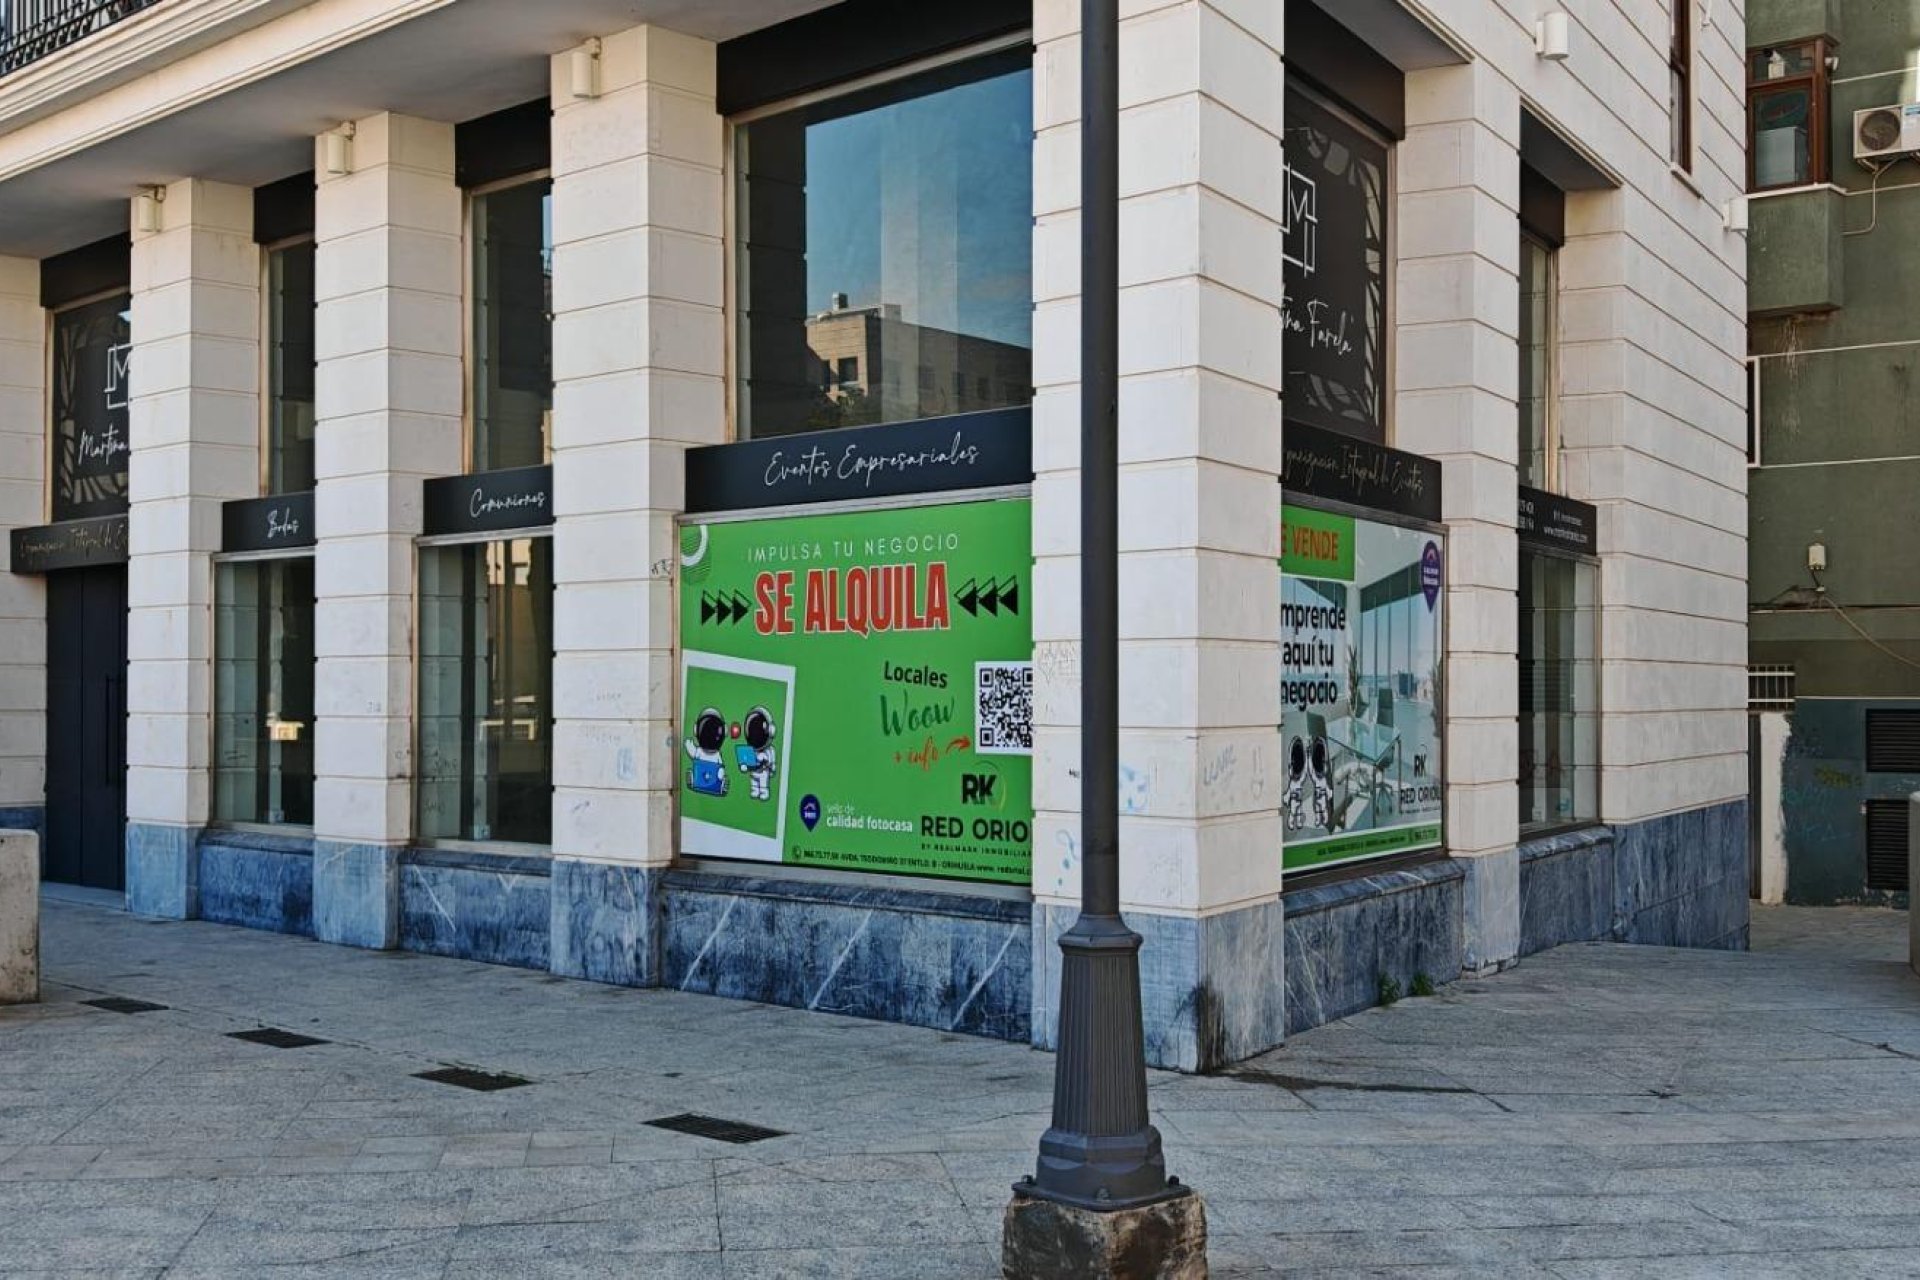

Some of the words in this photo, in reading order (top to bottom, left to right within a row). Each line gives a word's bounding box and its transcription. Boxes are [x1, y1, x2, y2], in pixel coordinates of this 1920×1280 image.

[764, 445, 832, 487] Eventos
[836, 431, 979, 488] Empresariales
[470, 488, 545, 518] Comuniones
[266, 506, 300, 539] Bodas
[747, 540, 823, 563] IMPULSA
[833, 540, 853, 558] TU
[864, 533, 959, 557] NEGOCIO
[1292, 526, 1339, 562] VENDE
[754, 570, 796, 636] SE
[803, 561, 951, 640] ALQUILA
[1281, 602, 1346, 635] mprende
[1283, 635, 1318, 674] aquí
[1318, 638, 1335, 667] tu
[884, 660, 948, 690] Locales
[962, 774, 997, 805] RK
[826, 815, 865, 829] calidad
[867, 815, 913, 832] fotocasa
[921, 815, 964, 840] RED
[972, 817, 1031, 843] ORIO
